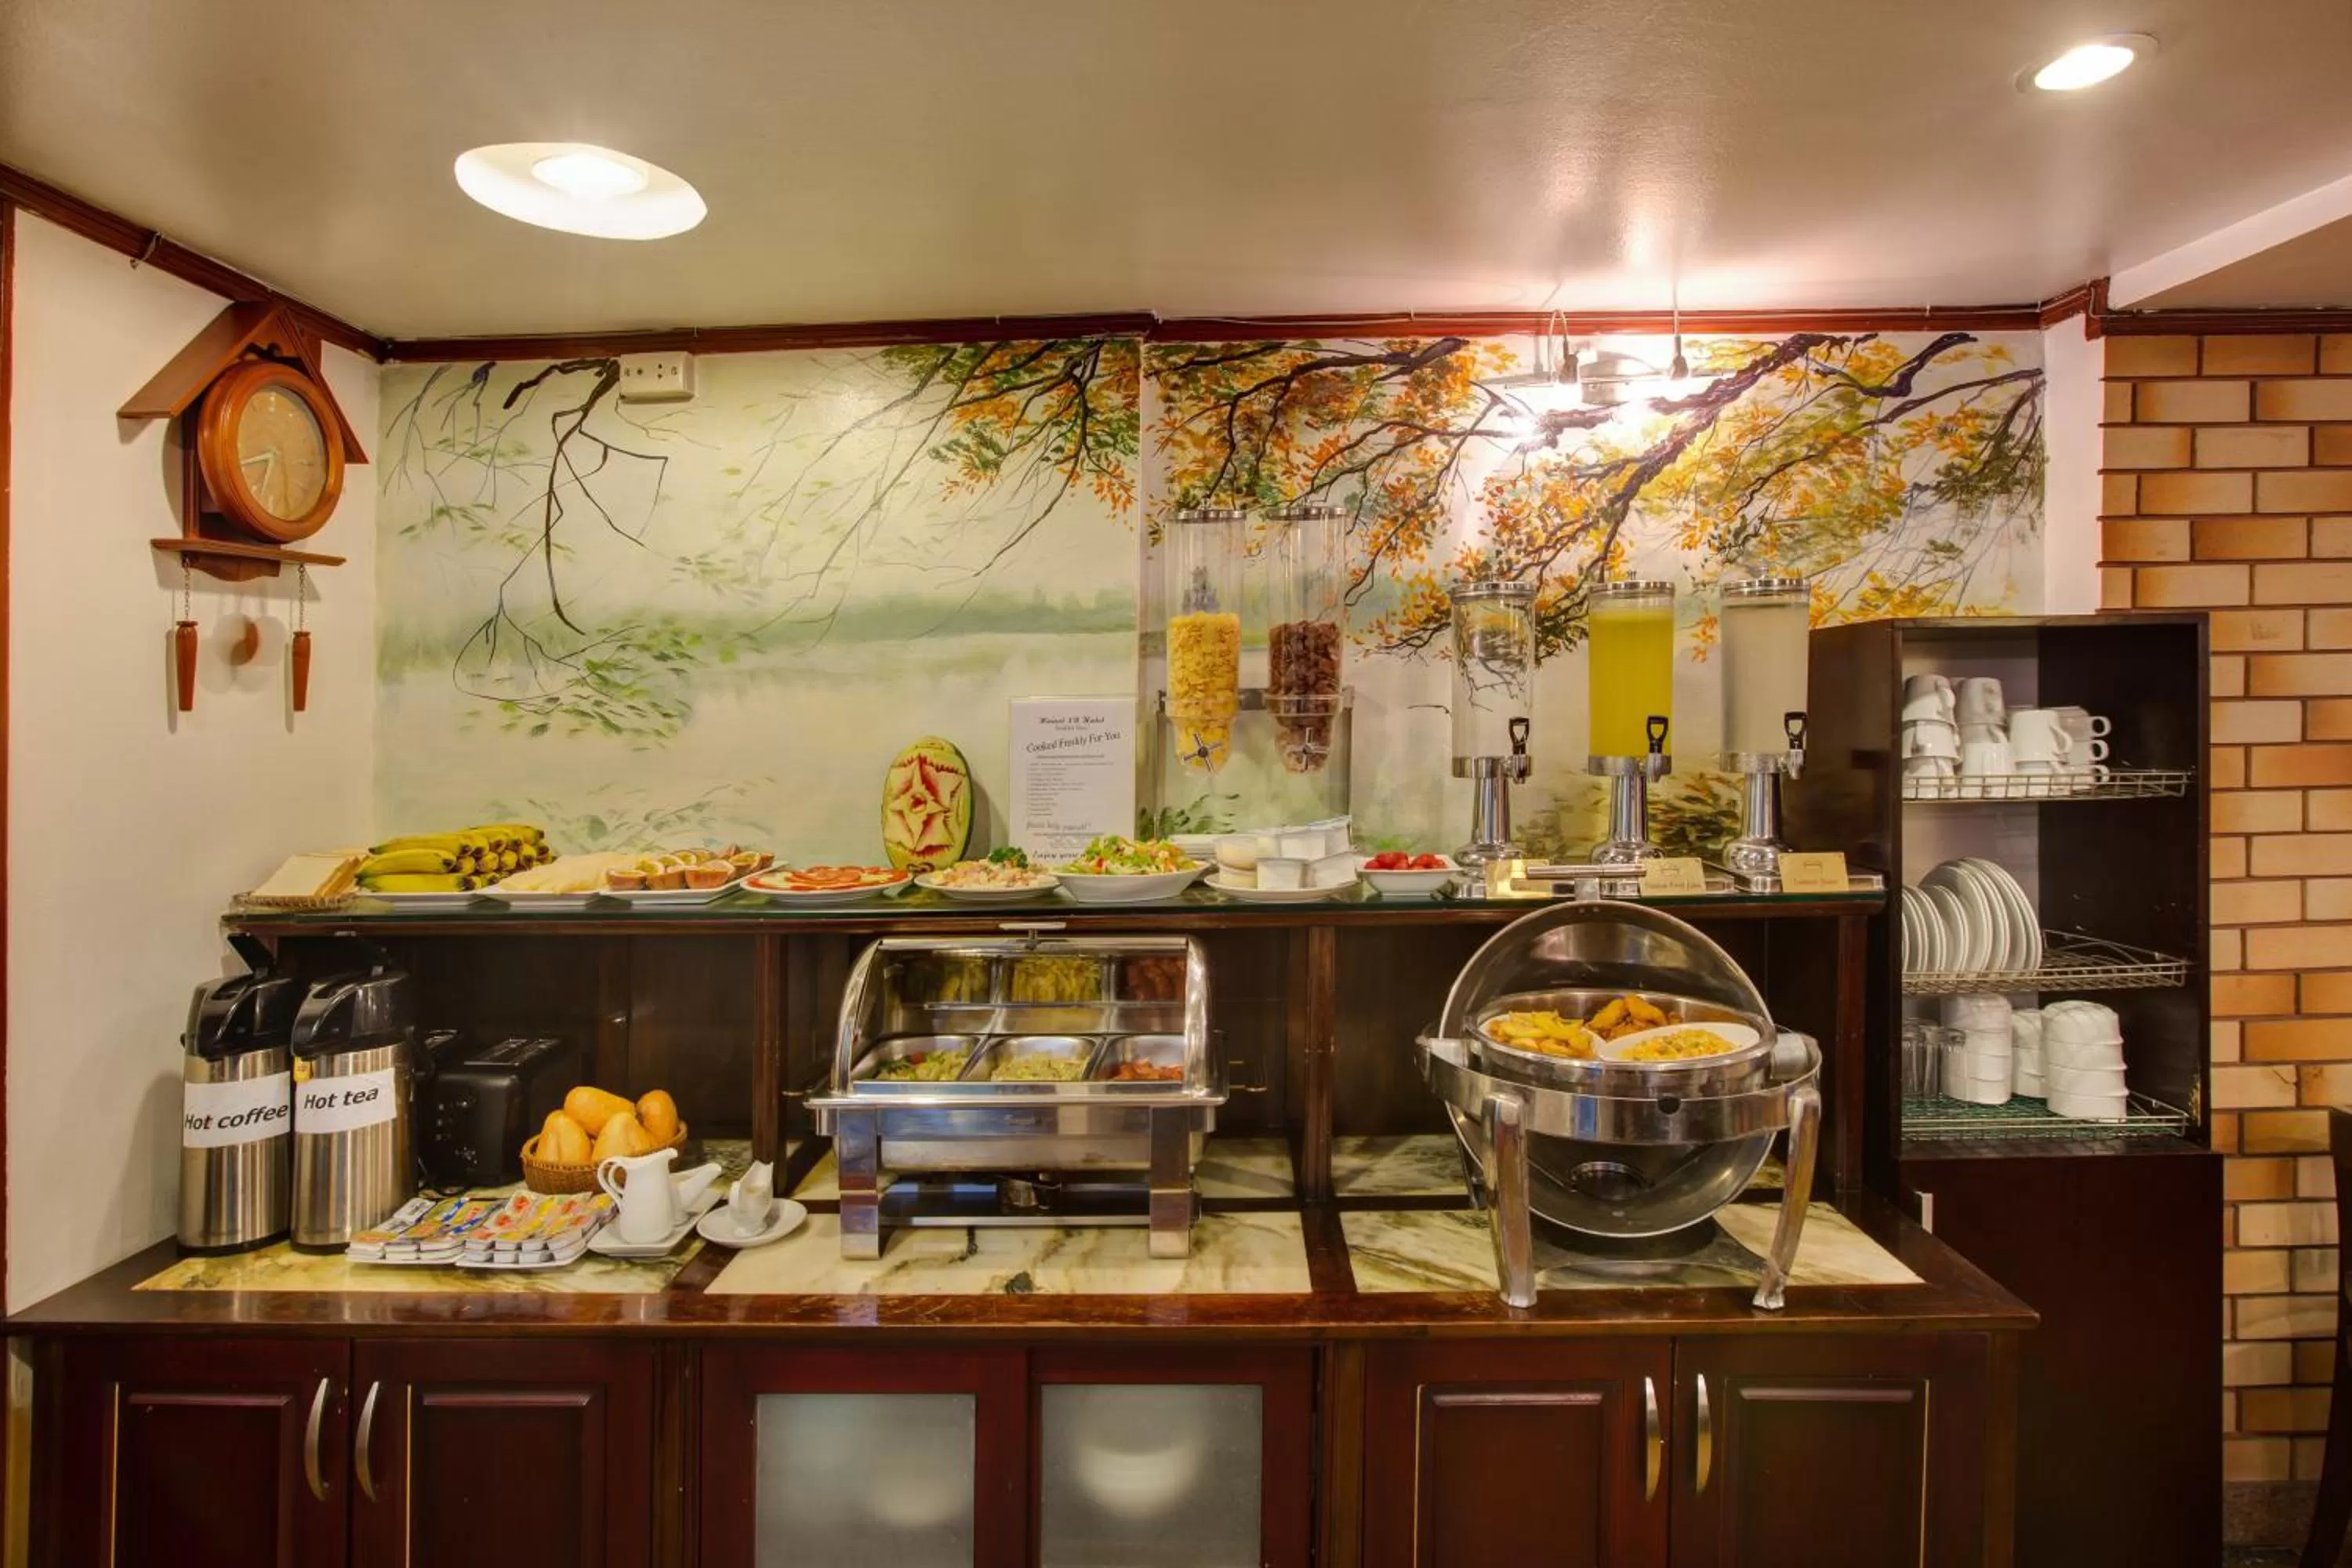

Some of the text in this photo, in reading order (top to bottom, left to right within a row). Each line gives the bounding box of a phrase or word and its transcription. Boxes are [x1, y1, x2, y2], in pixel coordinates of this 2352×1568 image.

[1026, 740, 1058, 753] Cooked
[1089, 733, 1102, 744] For
[1103, 731, 1120, 741] You
[304, 1087, 379, 1110] Hot tea
[184, 1103, 289, 1131] Hot coffee
